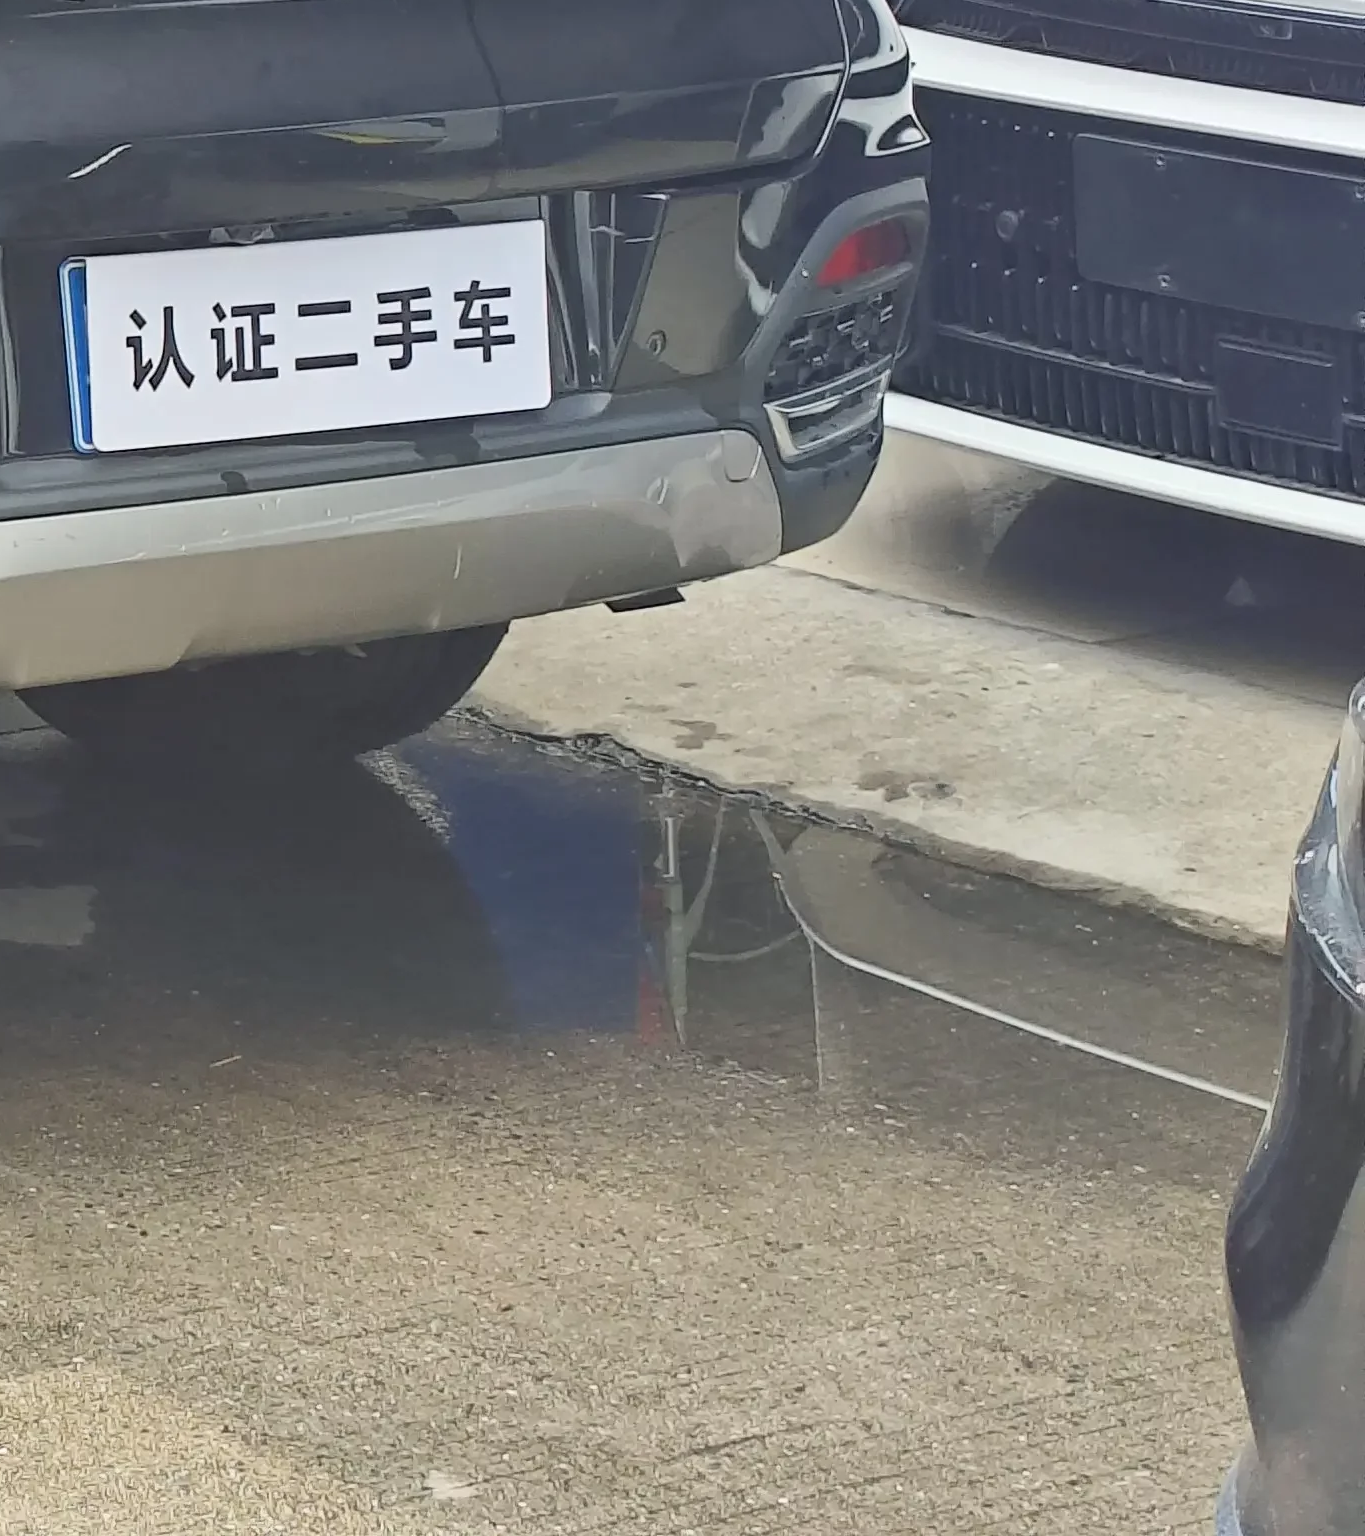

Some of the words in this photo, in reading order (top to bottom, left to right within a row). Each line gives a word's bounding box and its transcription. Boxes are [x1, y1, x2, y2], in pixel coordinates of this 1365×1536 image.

[125, 279, 516, 392] 认证二手车
